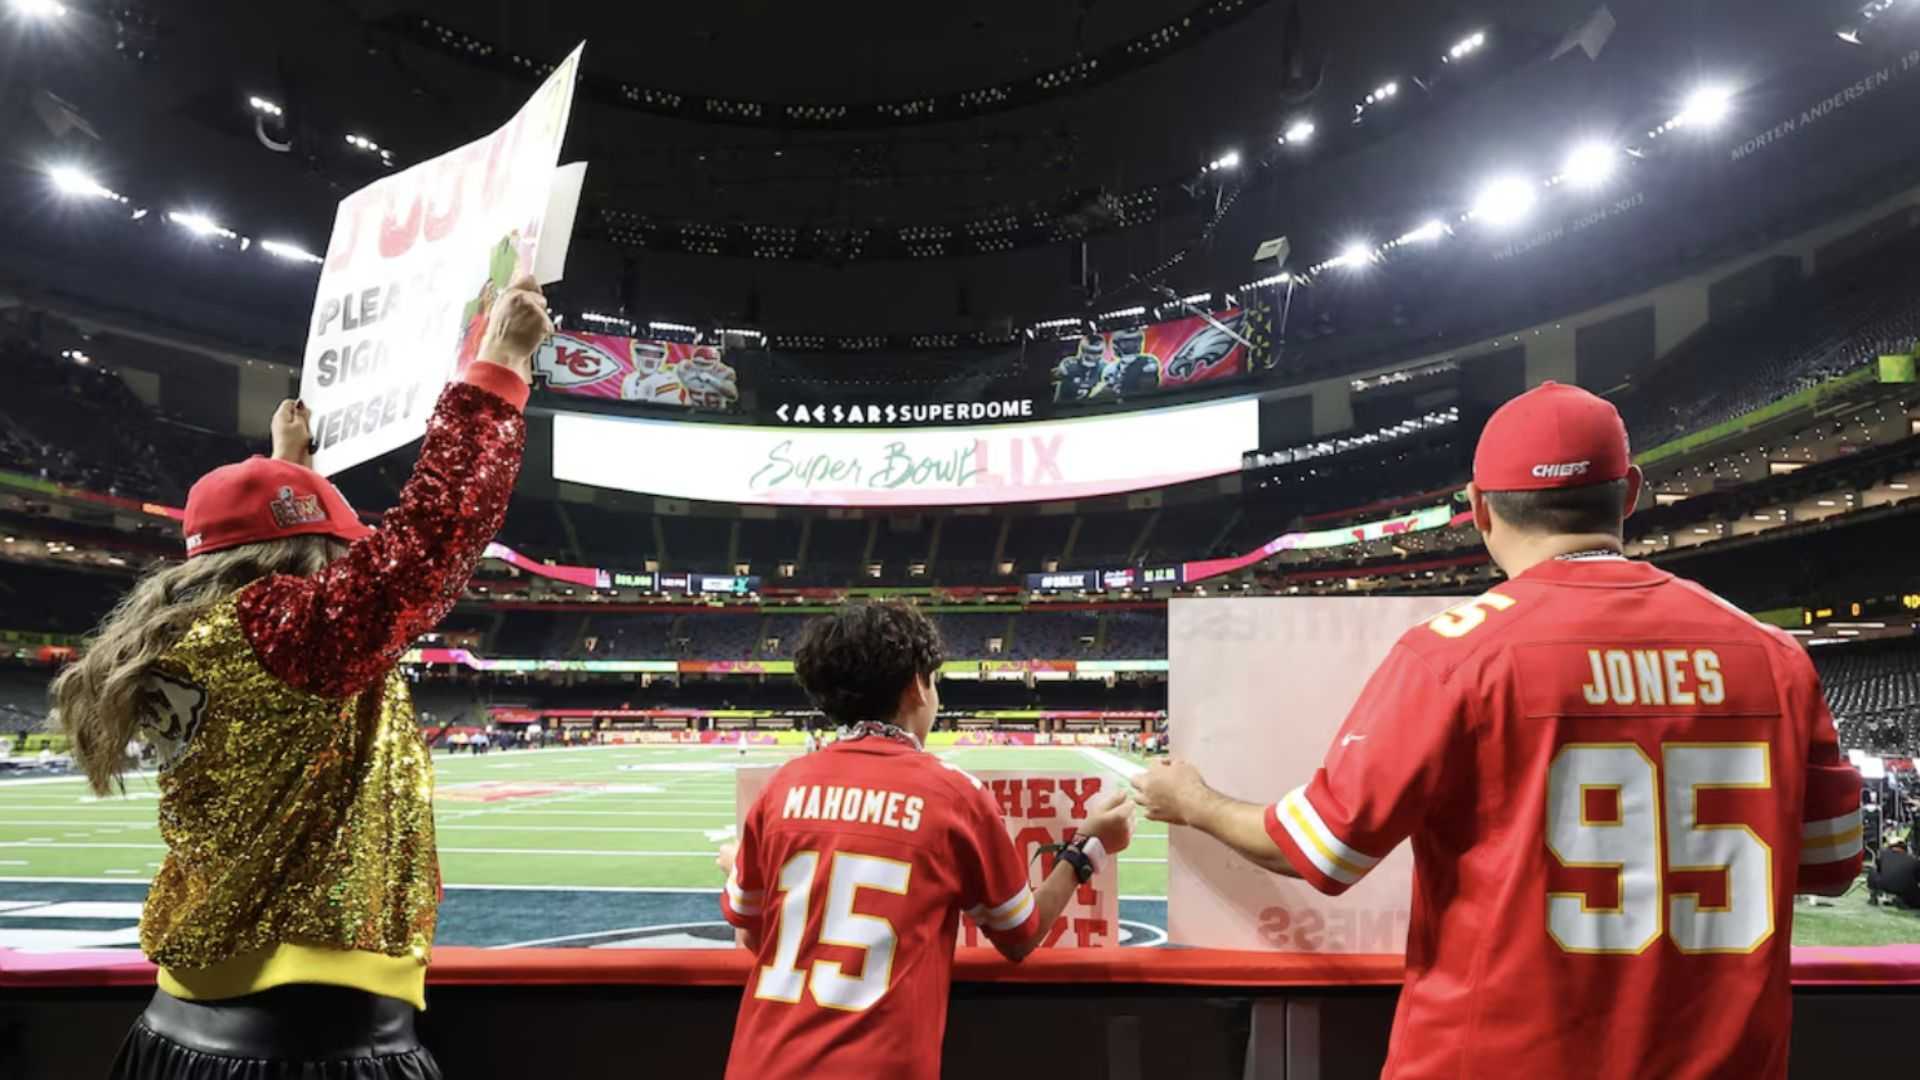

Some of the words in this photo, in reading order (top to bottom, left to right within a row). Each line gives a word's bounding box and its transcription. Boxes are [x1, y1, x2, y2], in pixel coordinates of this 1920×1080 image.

[1731, 119, 1796, 161] MORTEN
[1800, 68, 1889, 126] ANDERSEN
[776, 403, 898, 424] CAESARS
[900, 399, 1033, 421] SUPERDOME
[975, 434, 1066, 489] LIX
[1532, 460, 1591, 478] CHIEFS
[1583, 648, 1726, 705] JONES
[783, 785, 925, 832] MAHOMES
[984, 777, 1103, 820] HEY
[1545, 740, 1776, 955] 95
[753, 849, 913, 1013] 15
